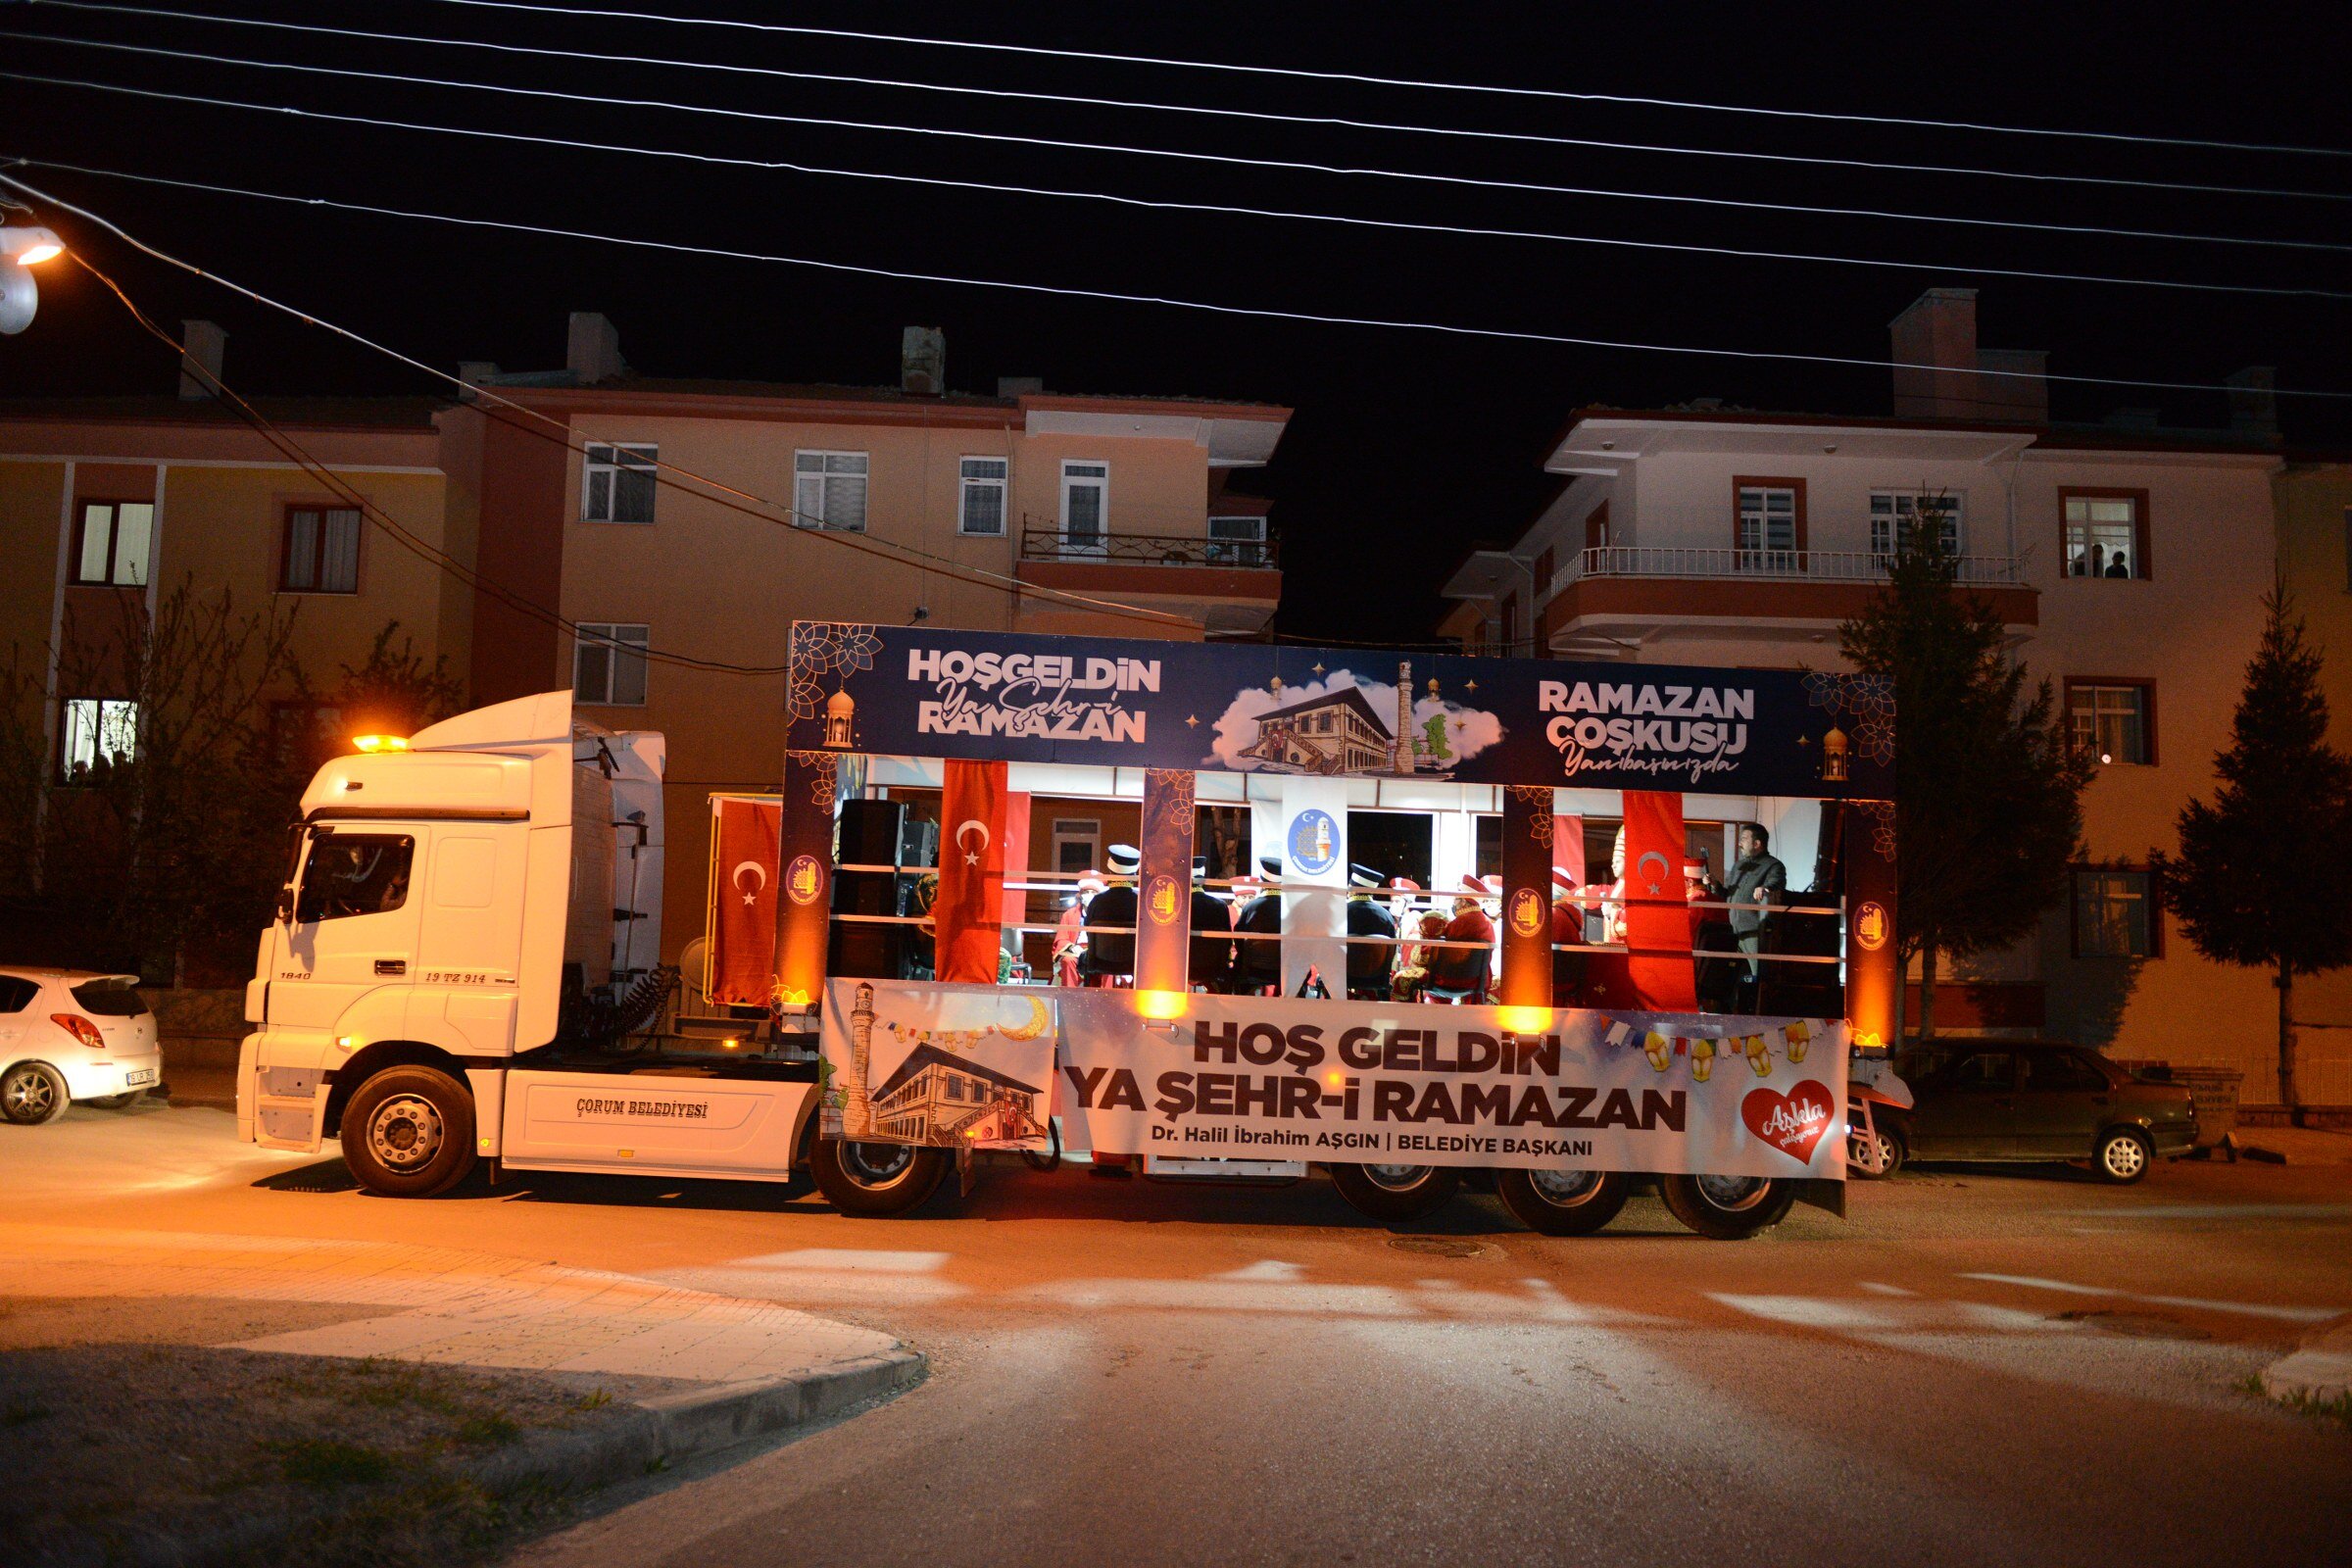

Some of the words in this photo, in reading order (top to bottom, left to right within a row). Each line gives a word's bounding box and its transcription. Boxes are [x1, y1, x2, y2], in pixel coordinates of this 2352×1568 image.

[936, 677, 991, 721] Ya
[1539, 680, 1754, 719] RAMAZAN
[917, 701, 1146, 743] RAMAZAN
[425, 972, 440, 982] 19
[443, 973, 462, 982] TZ
[464, 974, 486, 983] 914
[1194, 1021, 1326, 1076] HOŞ
[576, 1099, 625, 1117] ÇORUM
[628, 1100, 708, 1118] BELEDİYESİ
[1063, 1065, 1148, 1111] YA
[1373, 1080, 1687, 1133] RAMAZAN
[1762, 1098, 1826, 1136] Aşkla
[1152, 1125, 1178, 1141] Dr.
[1185, 1126, 1228, 1143] Halil
[1234, 1125, 1309, 1146] İbrahim
[1315, 1131, 1379, 1151] AŞGIN
[1397, 1133, 1496, 1153] BELEDİYE
[1502, 1138, 1592, 1157] BAŞKANI
